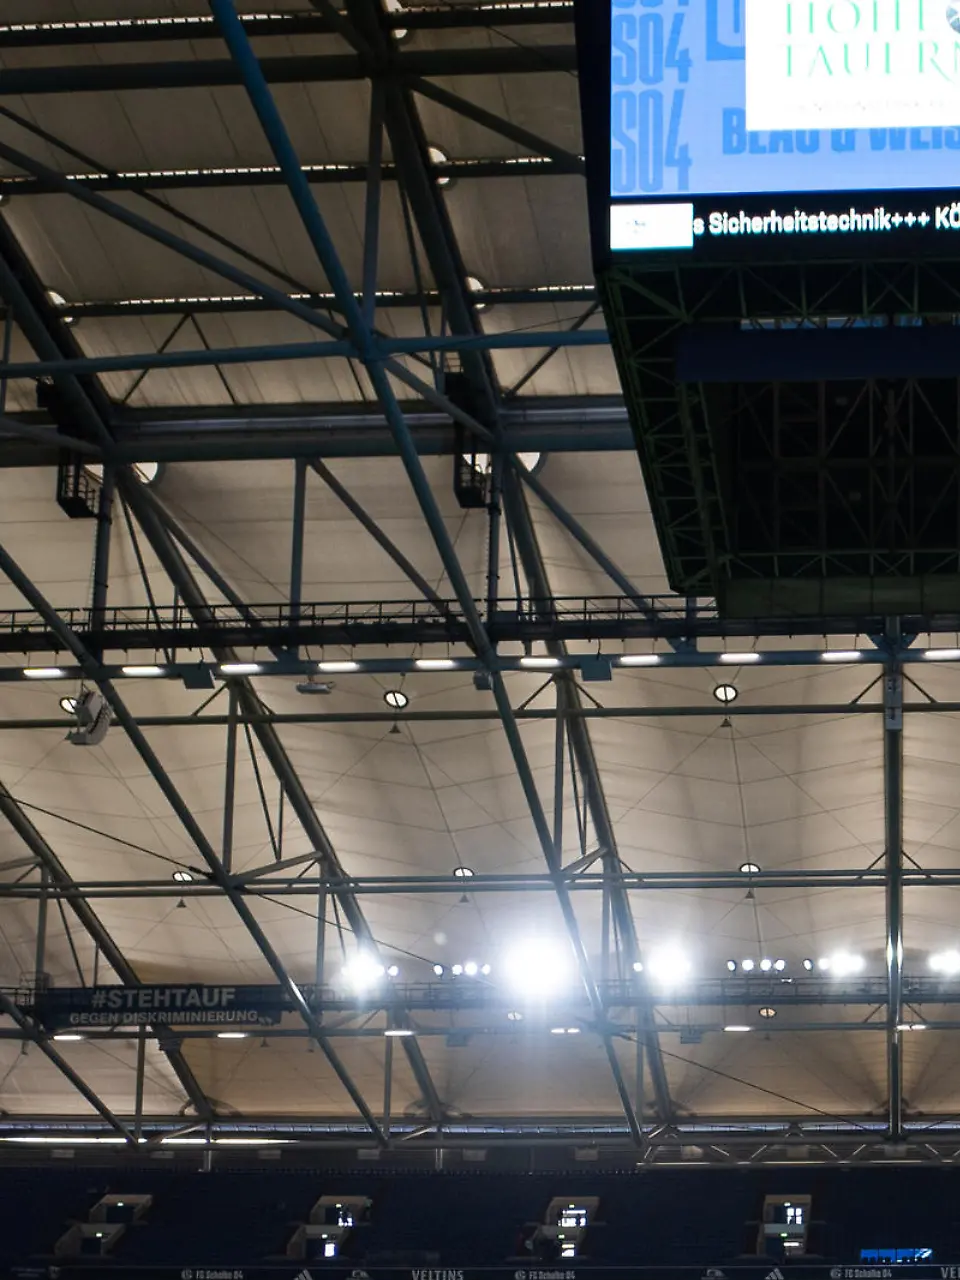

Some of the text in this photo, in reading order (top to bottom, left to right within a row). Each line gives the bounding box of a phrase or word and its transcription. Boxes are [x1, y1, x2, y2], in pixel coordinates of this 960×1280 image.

[91, 987, 236, 1009] #STEHTAUF
[69, 1009, 259, 1025] GEGEN DISKRIMINIERUNG
